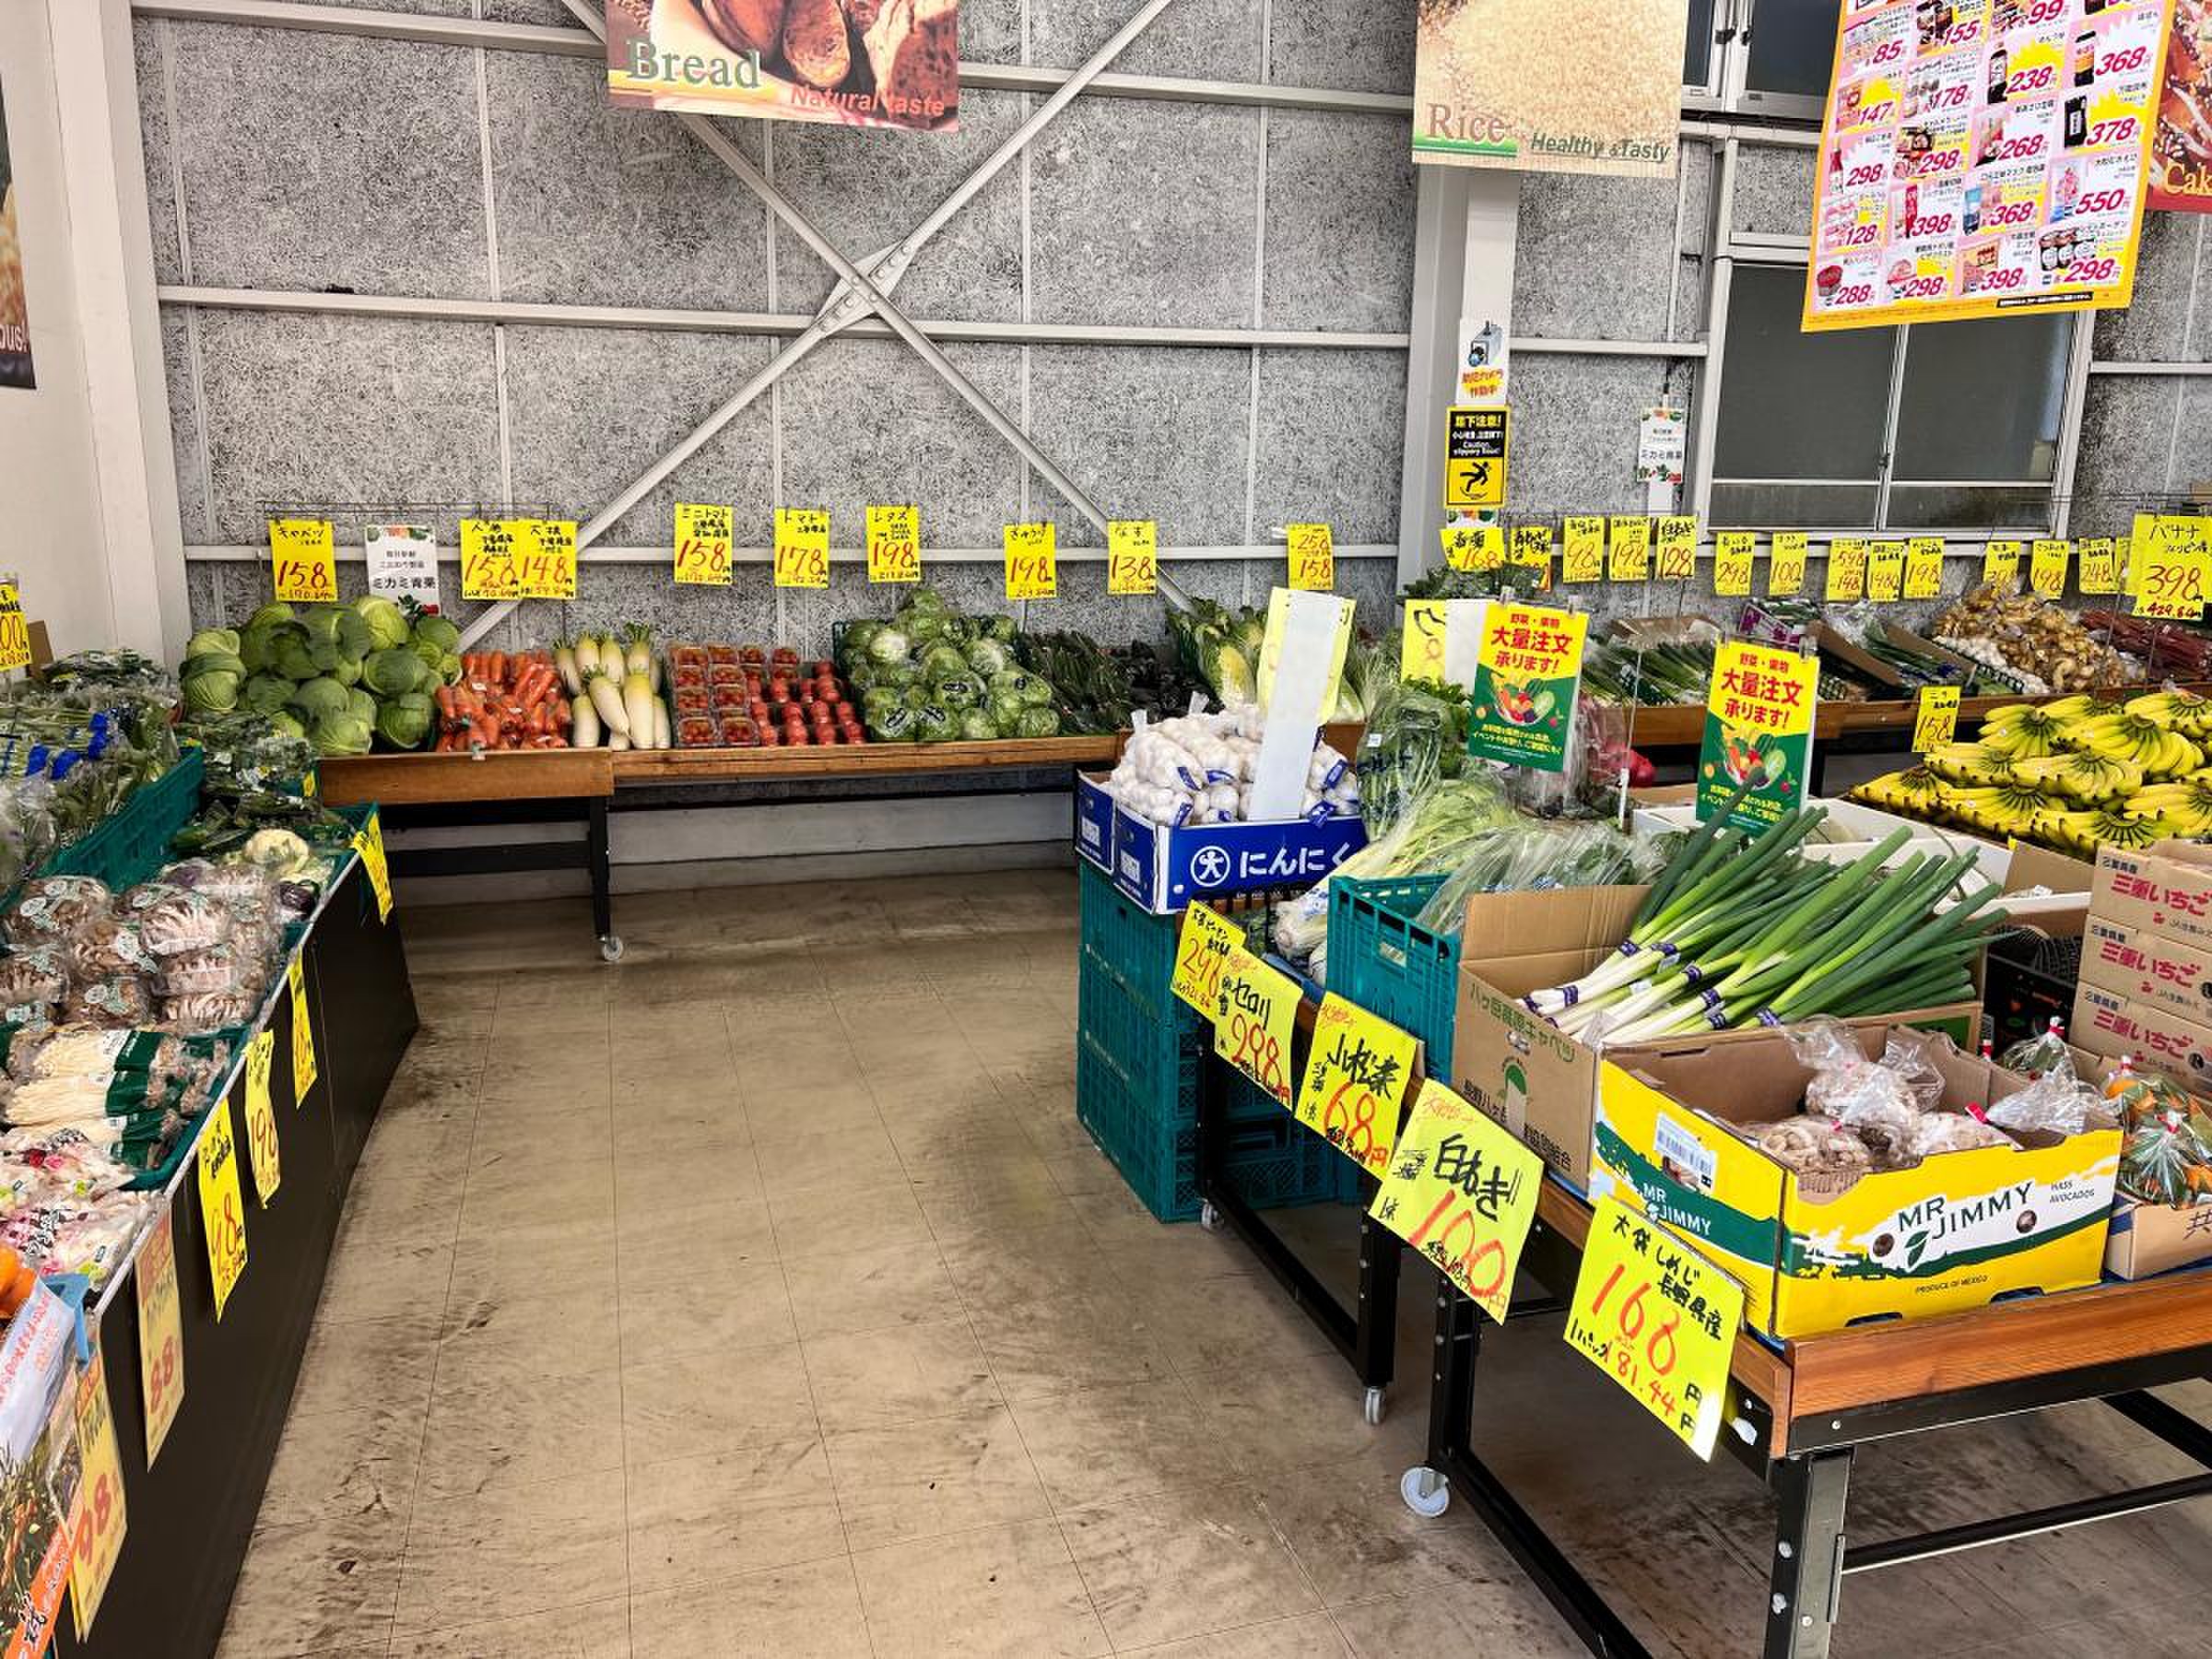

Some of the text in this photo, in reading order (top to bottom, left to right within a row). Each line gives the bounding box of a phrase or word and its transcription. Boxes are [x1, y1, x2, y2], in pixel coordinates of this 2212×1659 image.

[626, 38, 759, 89] Bread
[791, 87, 945, 117] Natural taste
[1428, 102, 1506, 144] Rice
[1531, 132, 1604, 159] Healthy
[1619, 138, 1671, 163] Tasty
[2149, 524, 2200, 541] バナナ
[1491, 627, 1572, 655] 大量注文
[1722, 669, 1803, 707] 大量注文
[1240, 841, 1350, 878] にんにく
[1231, 977, 1270, 1030] セロリ
[1642, 1182, 1667, 1204] MR
[1932, 1181, 2034, 1240] JIMMY
[1658, 1204, 1712, 1237] JIMMY
[1899, 1196, 1946, 1232] MR
[1656, 1245, 1700, 1287] しめじ
[1916, 1281, 1950, 1294] PRODUCE
[1961, 1275, 1989, 1286] MEXICO
